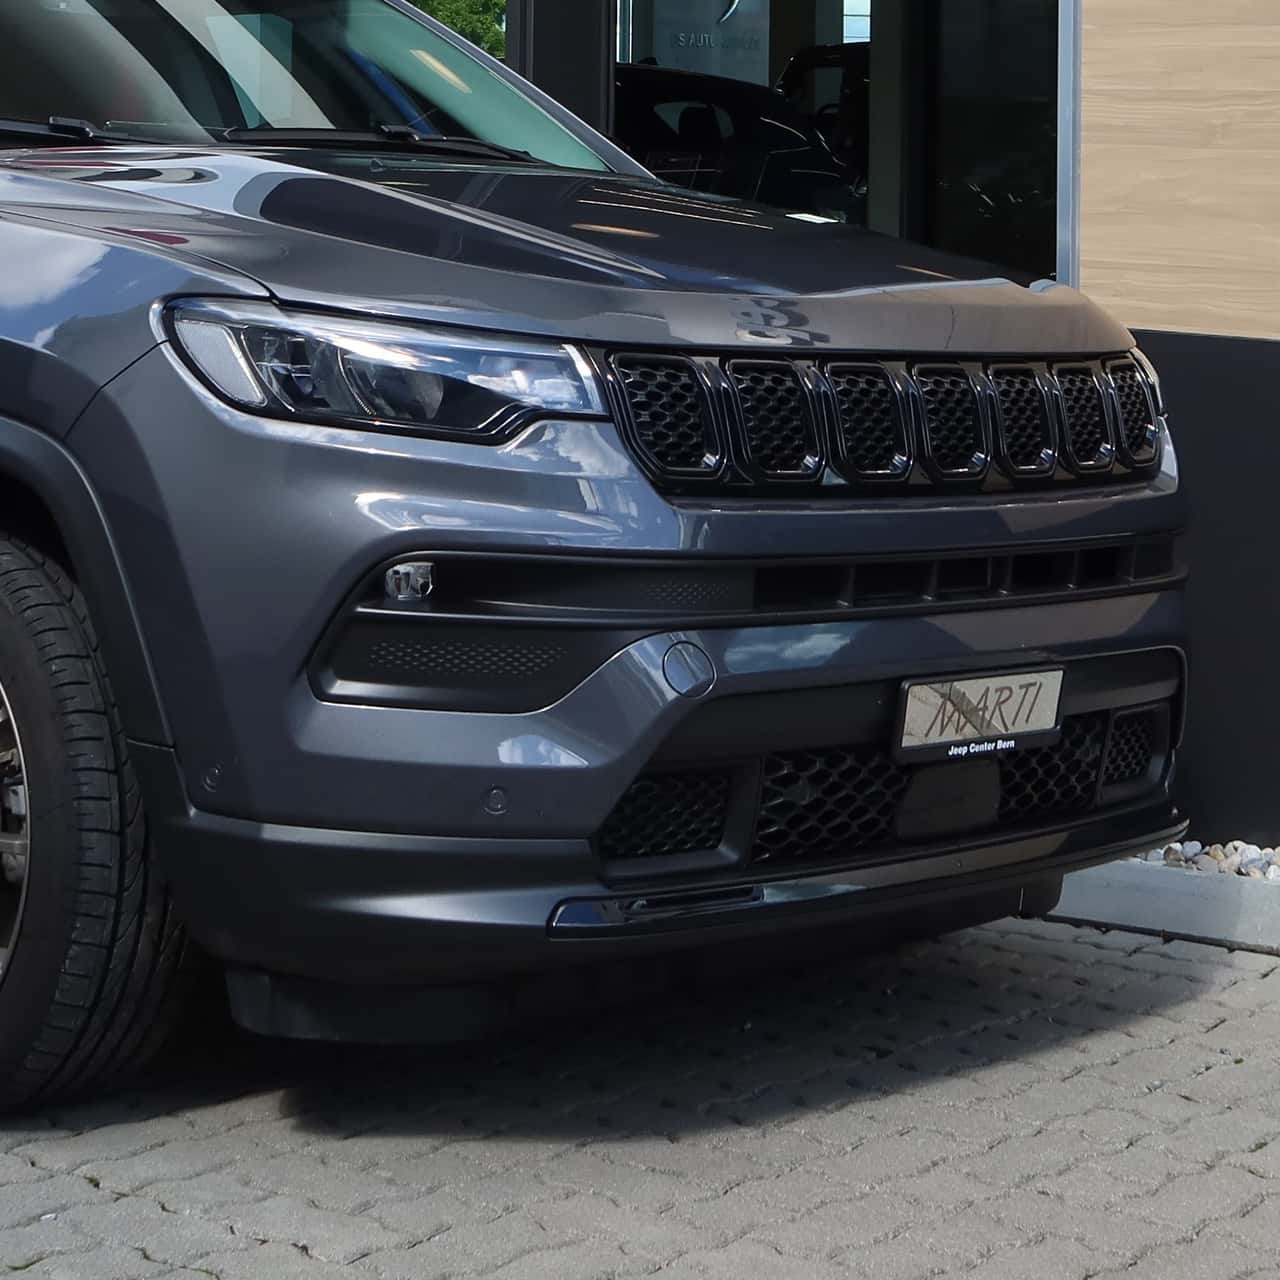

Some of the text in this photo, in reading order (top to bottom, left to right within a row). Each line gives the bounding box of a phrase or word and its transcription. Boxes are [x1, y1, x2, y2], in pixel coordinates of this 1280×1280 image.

[925, 680, 1042, 738] MARTI
[948, 739, 1015, 757] Jeep Center Bern
